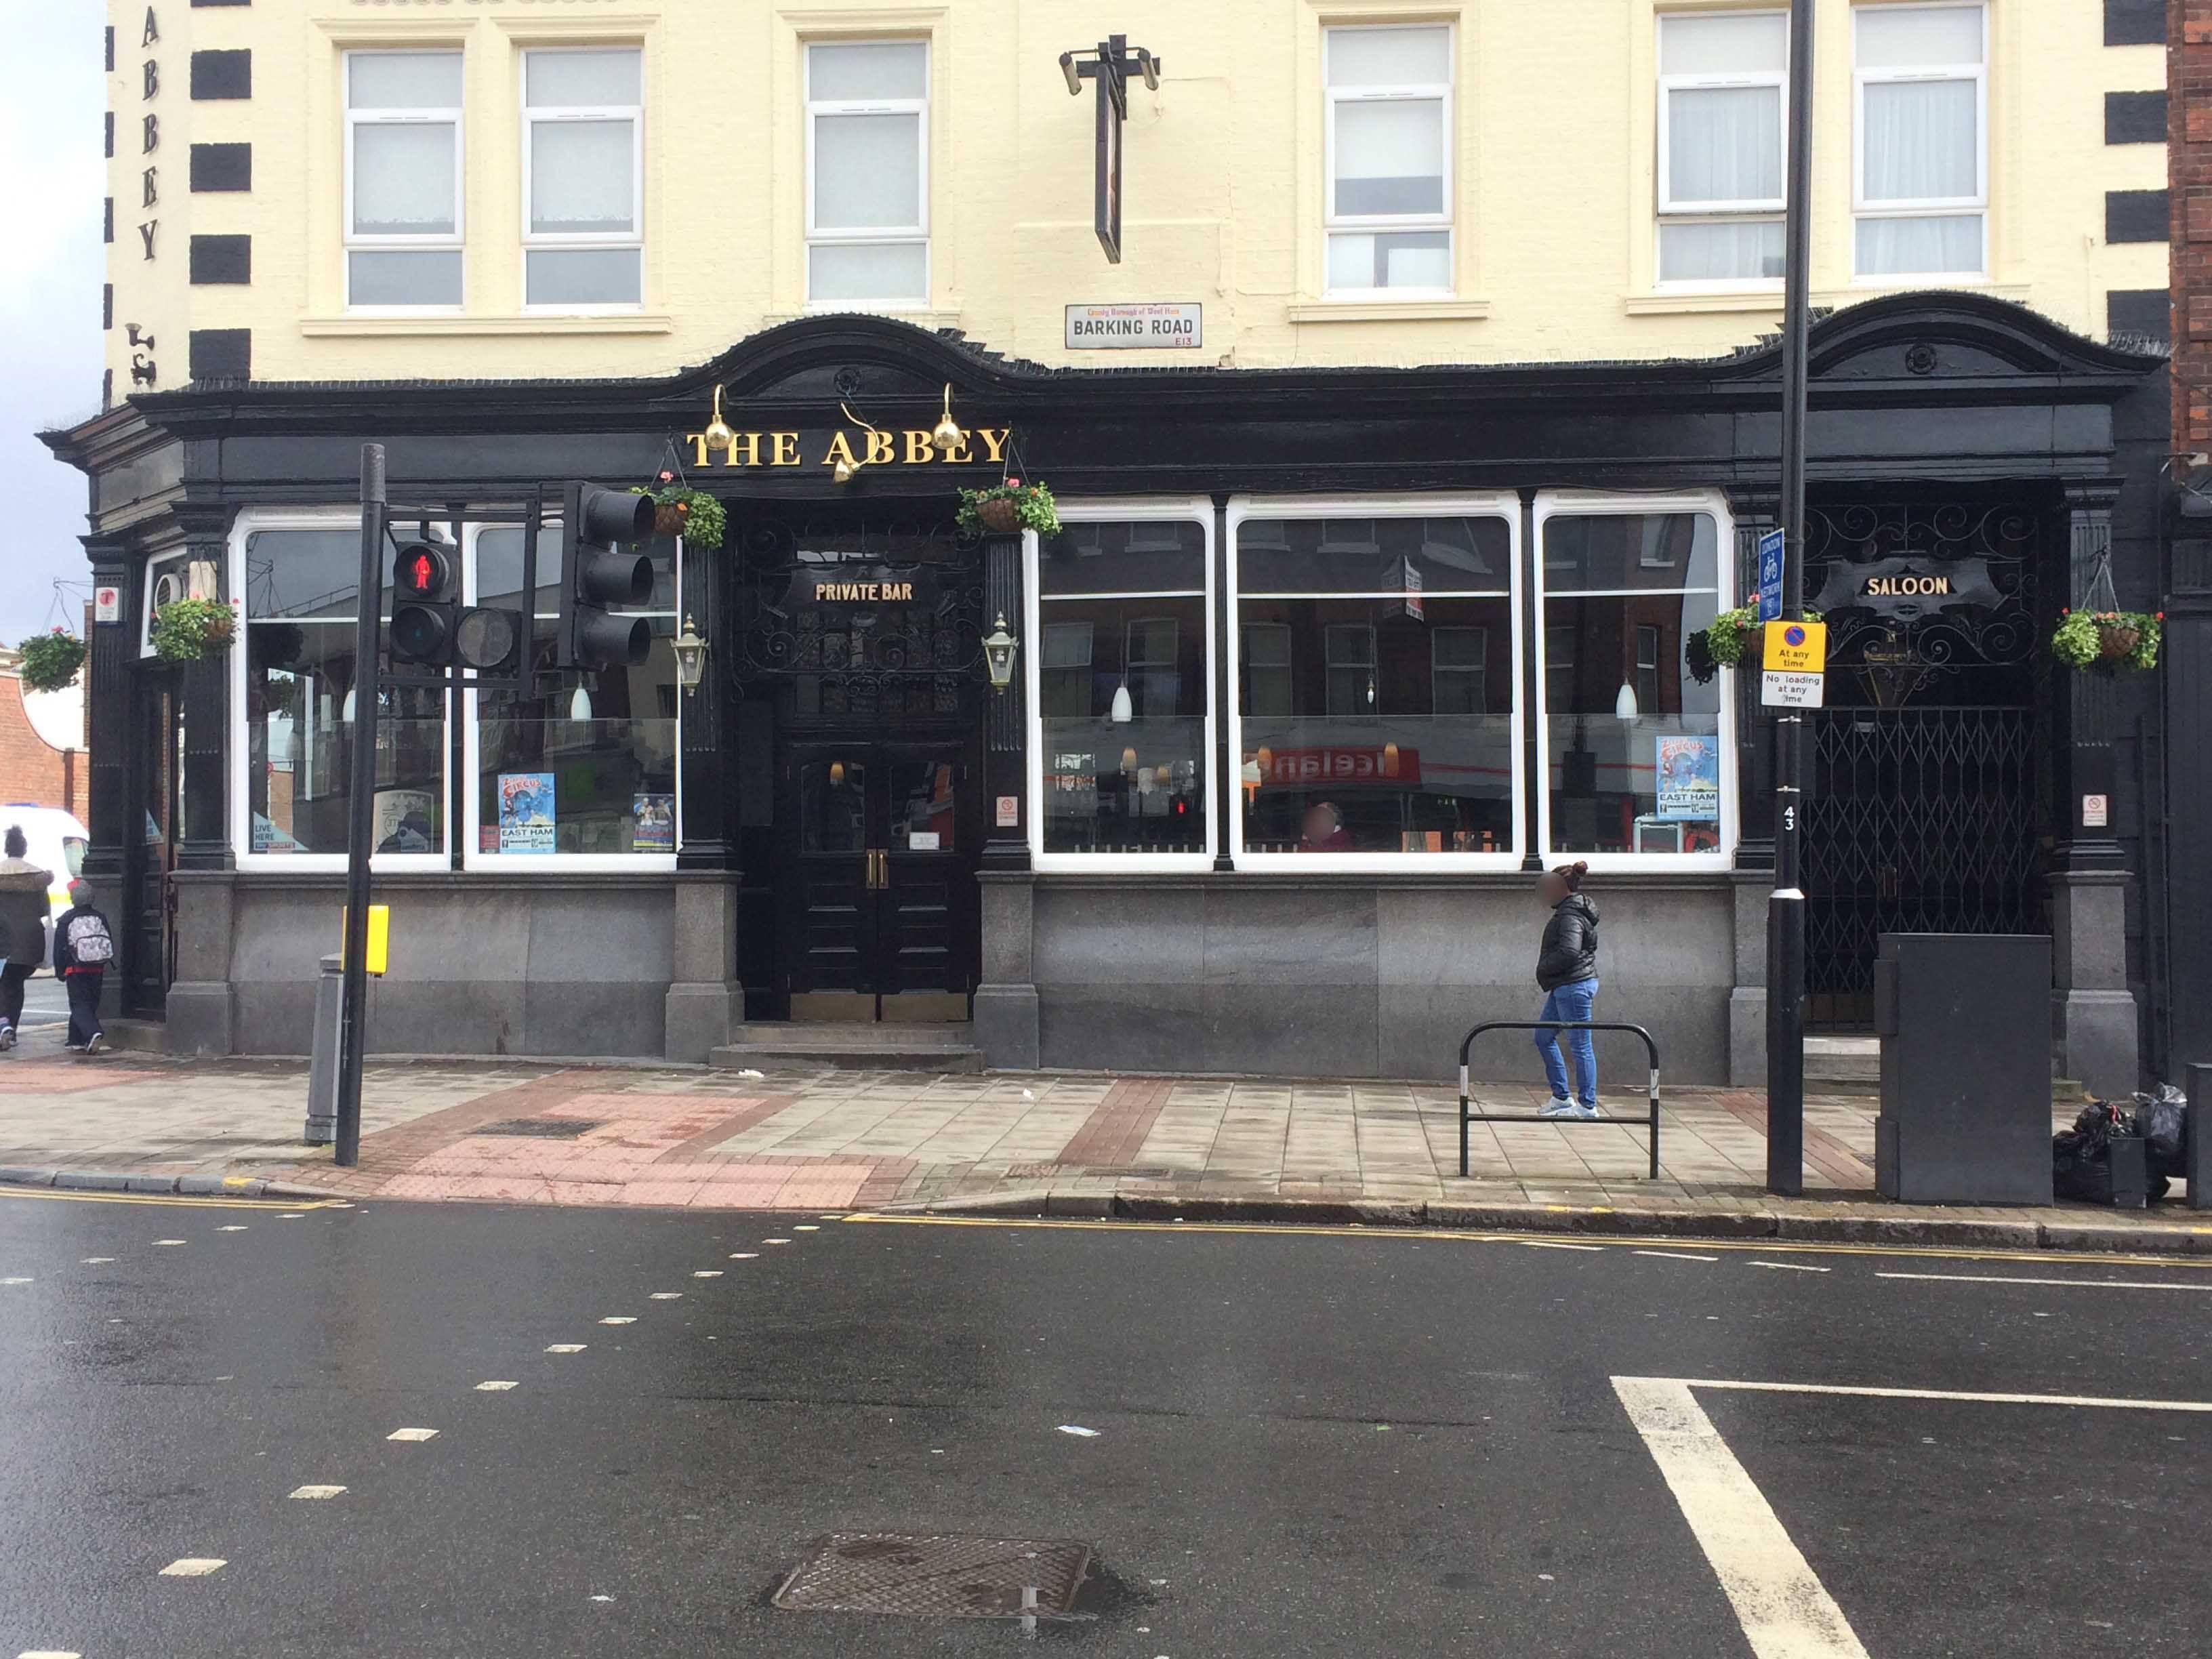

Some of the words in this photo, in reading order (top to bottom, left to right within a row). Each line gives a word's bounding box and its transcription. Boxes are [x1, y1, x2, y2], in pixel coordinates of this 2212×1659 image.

[138, 5, 158, 261] ABBEY
[1074, 320, 1143, 335] BARKING
[1152, 319, 1193, 334] ROAD
[1175, 337, 1192, 346] E13
[687, 432, 802, 466] THE
[821, 428, 1011, 465] ABBEY
[816, 583, 878, 600] PRIVATE
[882, 583, 912, 600] BAR
[1868, 577, 1948, 595] SALOON
[1779, 649, 1790, 657] At
[1793, 651, 1809, 659] any
[1766, 674, 1780, 682] No
[1786, 676, 1820, 686] loading
[1790, 687, 1807, 695] any
[255, 833, 274, 841] HERE
